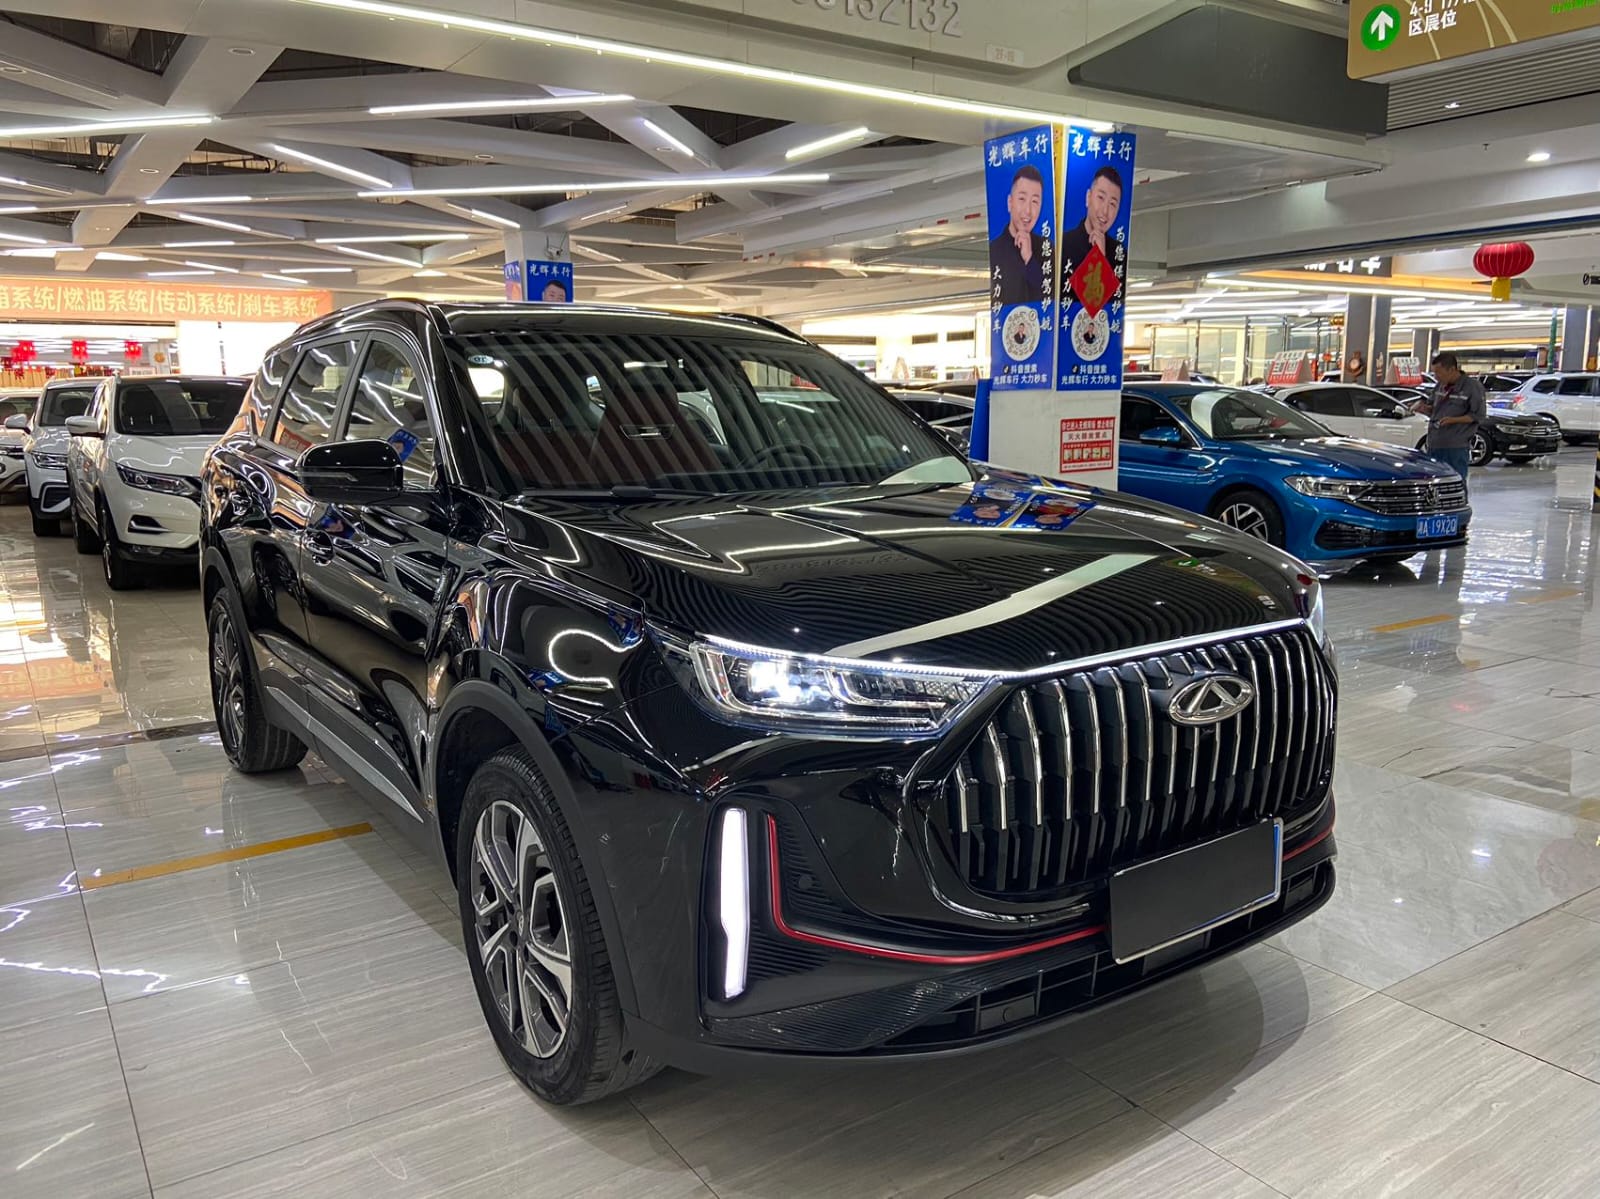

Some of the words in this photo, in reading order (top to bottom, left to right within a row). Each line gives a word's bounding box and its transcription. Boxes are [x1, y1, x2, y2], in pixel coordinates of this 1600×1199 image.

[1409, 10, 1457, 37] 区展位
[1040, 220, 1053, 332] 为您保驾护航
[1083, 261, 1105, 307] 福
